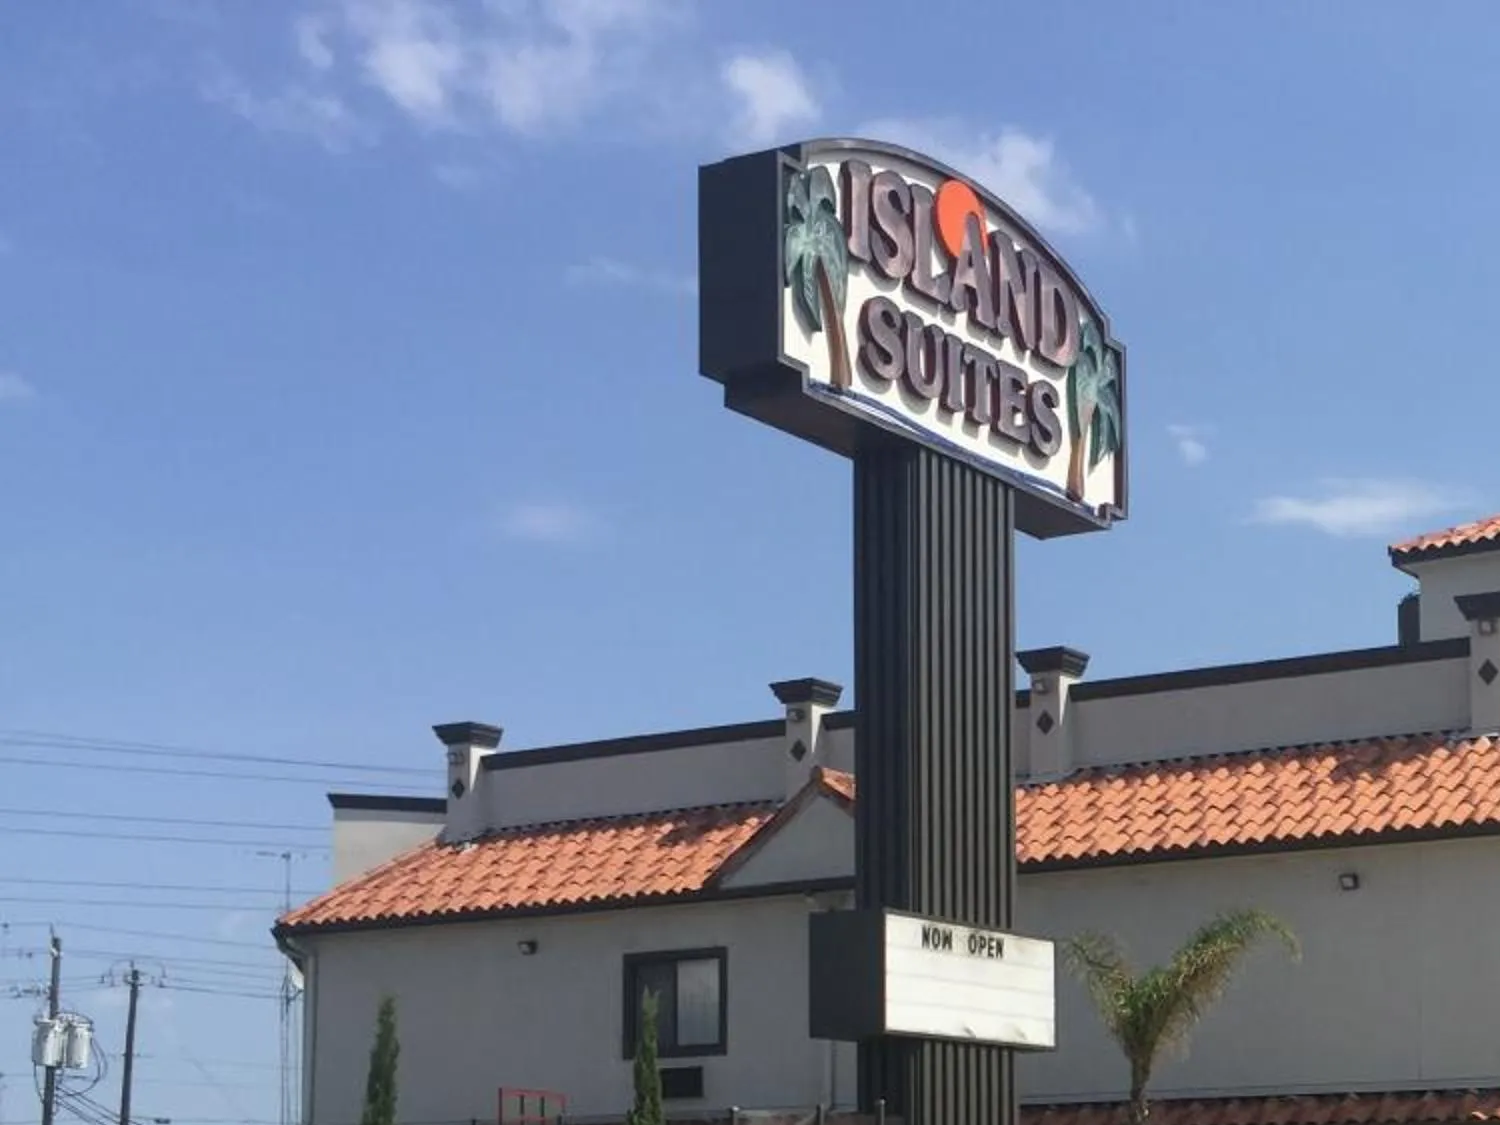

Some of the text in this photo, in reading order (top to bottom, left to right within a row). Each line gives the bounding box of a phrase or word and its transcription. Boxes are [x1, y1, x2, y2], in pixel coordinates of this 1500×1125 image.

[839, 158, 1081, 369] ISLAND
[857, 295, 1064, 459] SUITES
[921, 925, 1005, 960] NOW OPEN
